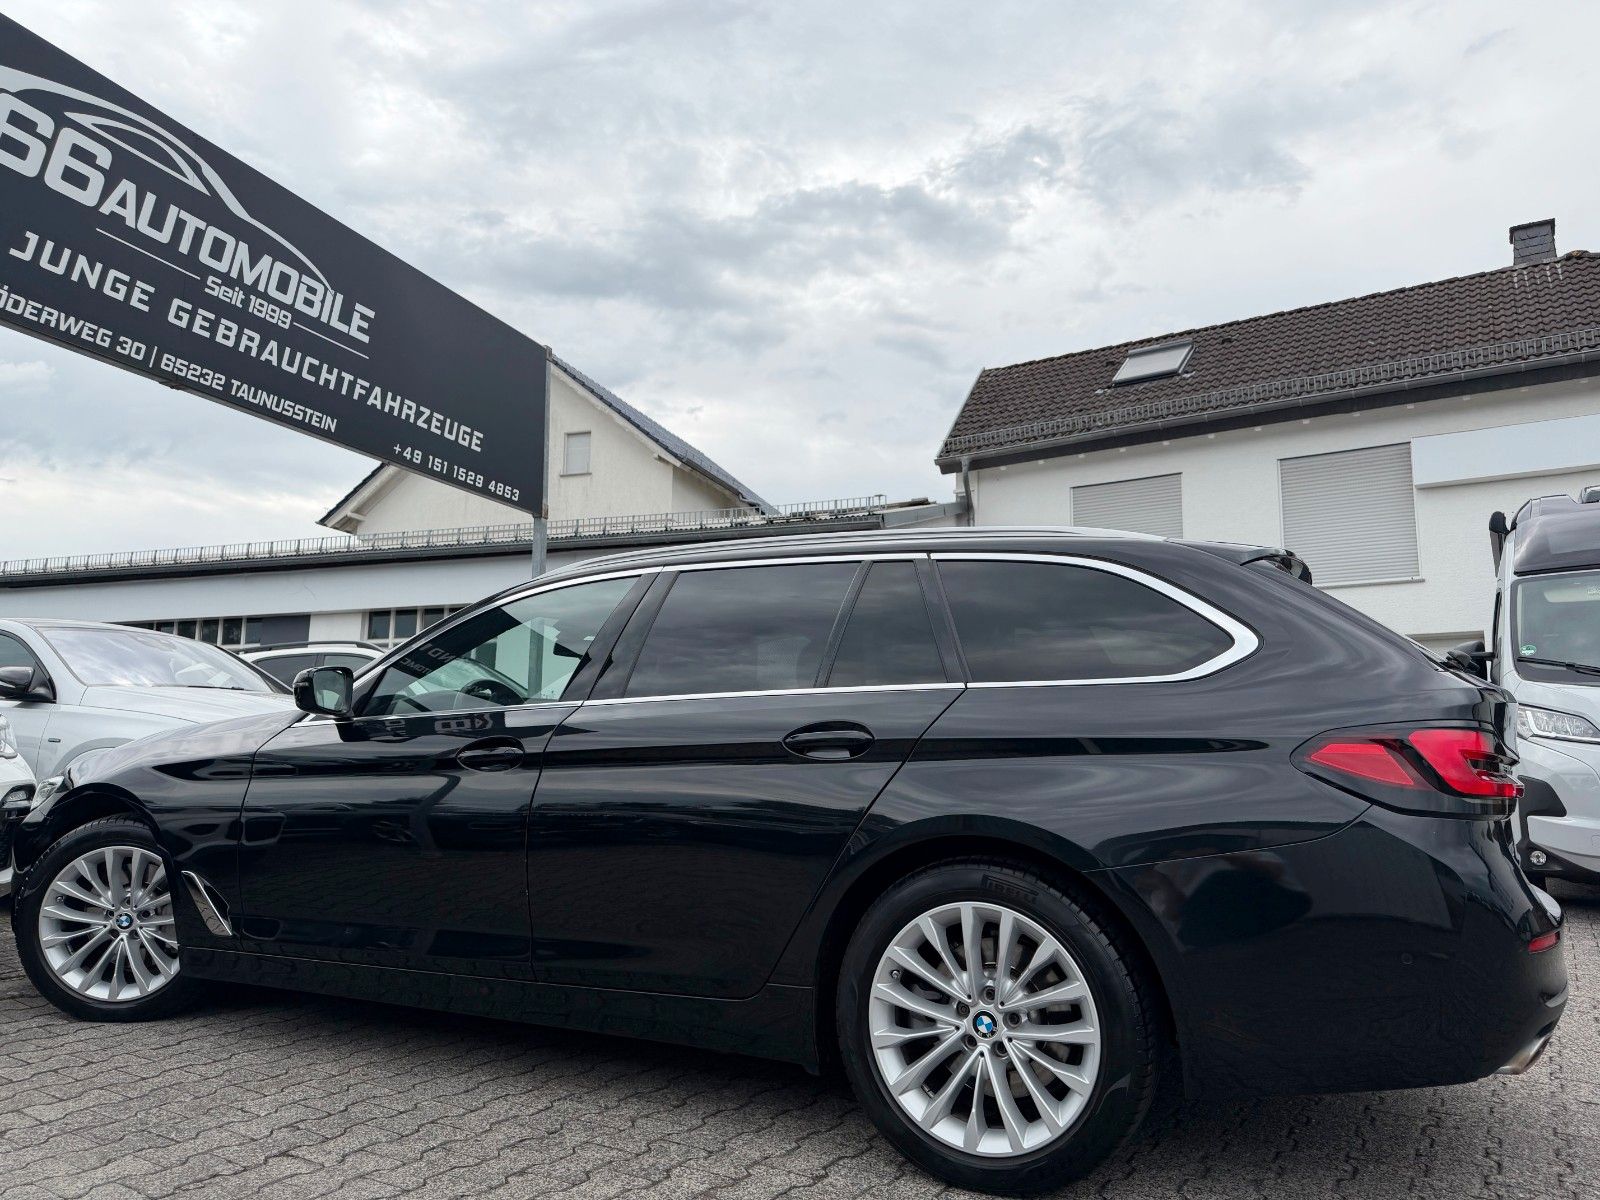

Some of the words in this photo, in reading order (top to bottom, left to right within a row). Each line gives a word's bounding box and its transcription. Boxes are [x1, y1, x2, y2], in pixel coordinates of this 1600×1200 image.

[204, 274, 246, 309] Seit
[248, 294, 292, 330] 1999
[8, 230, 156, 313] JUNGE
[167, 297, 485, 453] GEBRAUCHTFAHRZEUGE
[116, 335, 146, 361] 30
[160, 353, 226, 391] 65232
[230, 378, 338, 433] TAUNUSSTEIN
[393, 443, 423, 464] +49
[428, 455, 448, 474] 151
[453, 465, 484, 488] 1529
[488, 480, 520, 502] 4853
